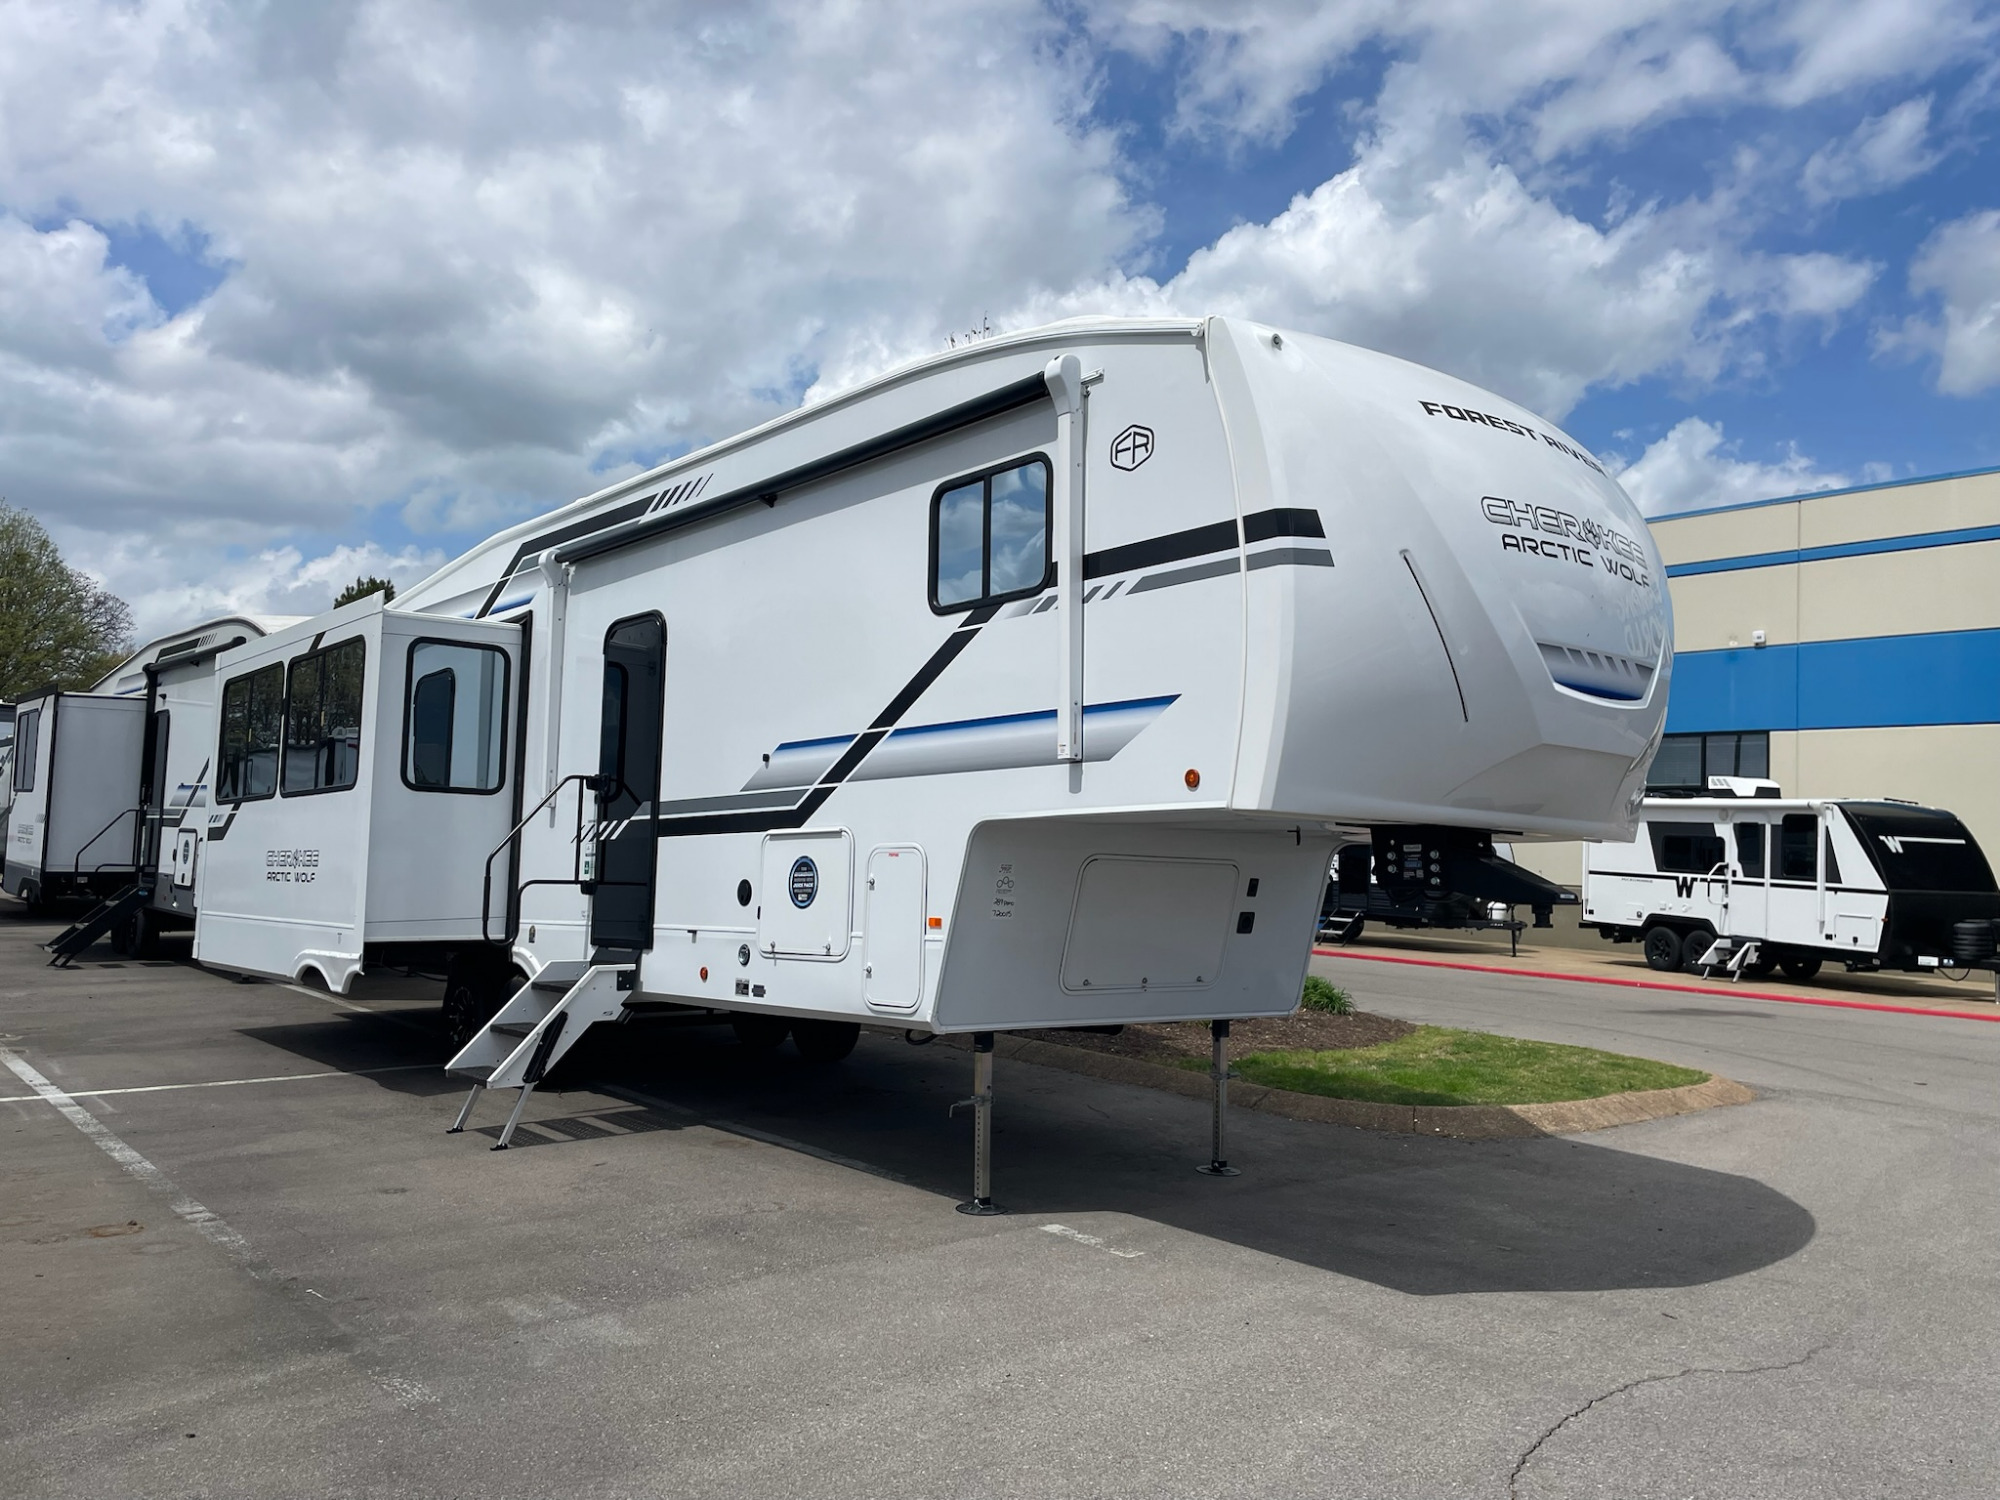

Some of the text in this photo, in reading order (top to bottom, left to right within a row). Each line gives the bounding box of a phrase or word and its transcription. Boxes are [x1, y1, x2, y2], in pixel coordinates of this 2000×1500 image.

[1418, 400, 1608, 479] FOREST RIVER
[1501, 533, 1650, 588] ARCTIC WOLF
[266, 871, 316, 883] ARCTIC WOLF
